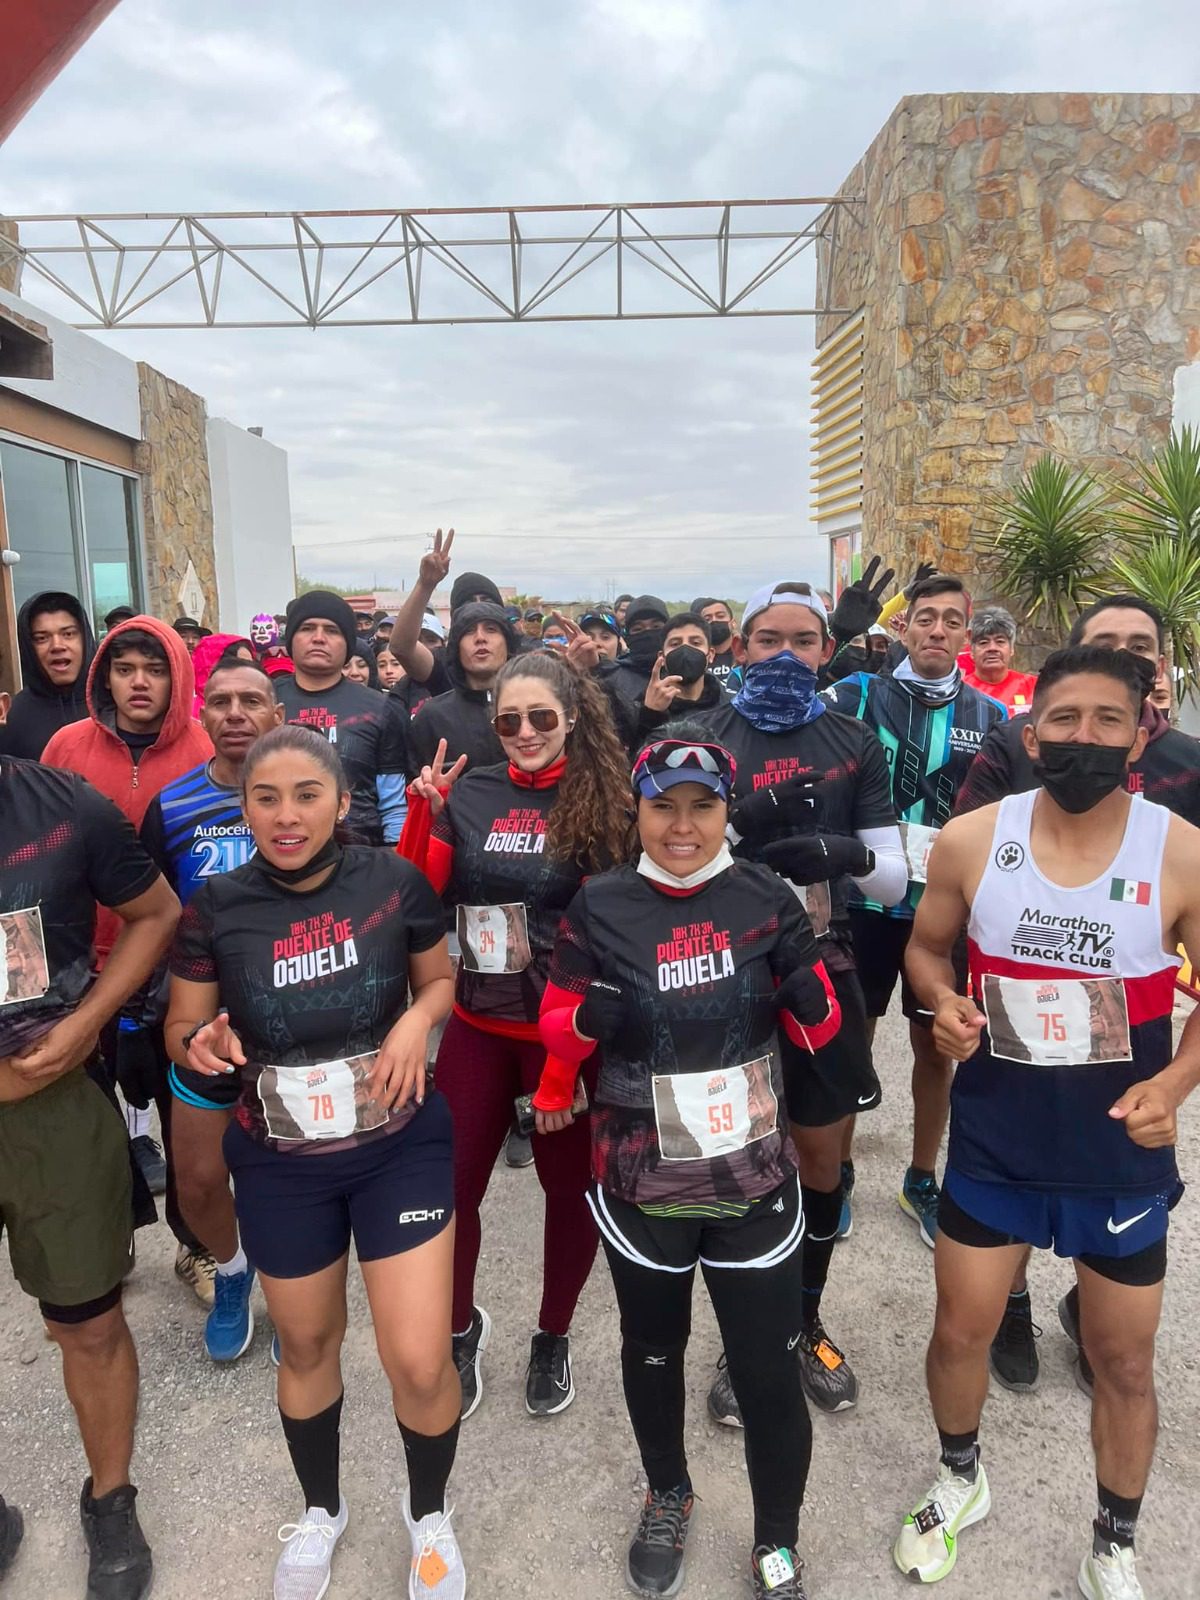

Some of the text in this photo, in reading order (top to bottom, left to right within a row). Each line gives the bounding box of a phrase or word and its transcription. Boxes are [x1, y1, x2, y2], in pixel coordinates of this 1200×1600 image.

[325, 714, 337, 728] DE
[950, 727, 985, 743] XXIV
[1128, 772, 1145, 792] DE
[490, 818, 533, 833] PUENTE
[484, 832, 546, 854] OJUELA
[273, 918, 354, 961] PUENTE DE
[480, 930, 496, 954] 34
[672, 921, 714, 941] 10K 7K 3K
[657, 930, 731, 964] PUENTE DE
[1011, 944, 1112, 969] TRACK CLUB
[273, 938, 359, 988] OJUELA
[658, 948, 735, 992] OJUELA
[1037, 1013, 1067, 1041] 75
[308, 1094, 335, 1121] 78
[707, 1102, 734, 1134] 59
[399, 1209, 445, 1224] ECHT
